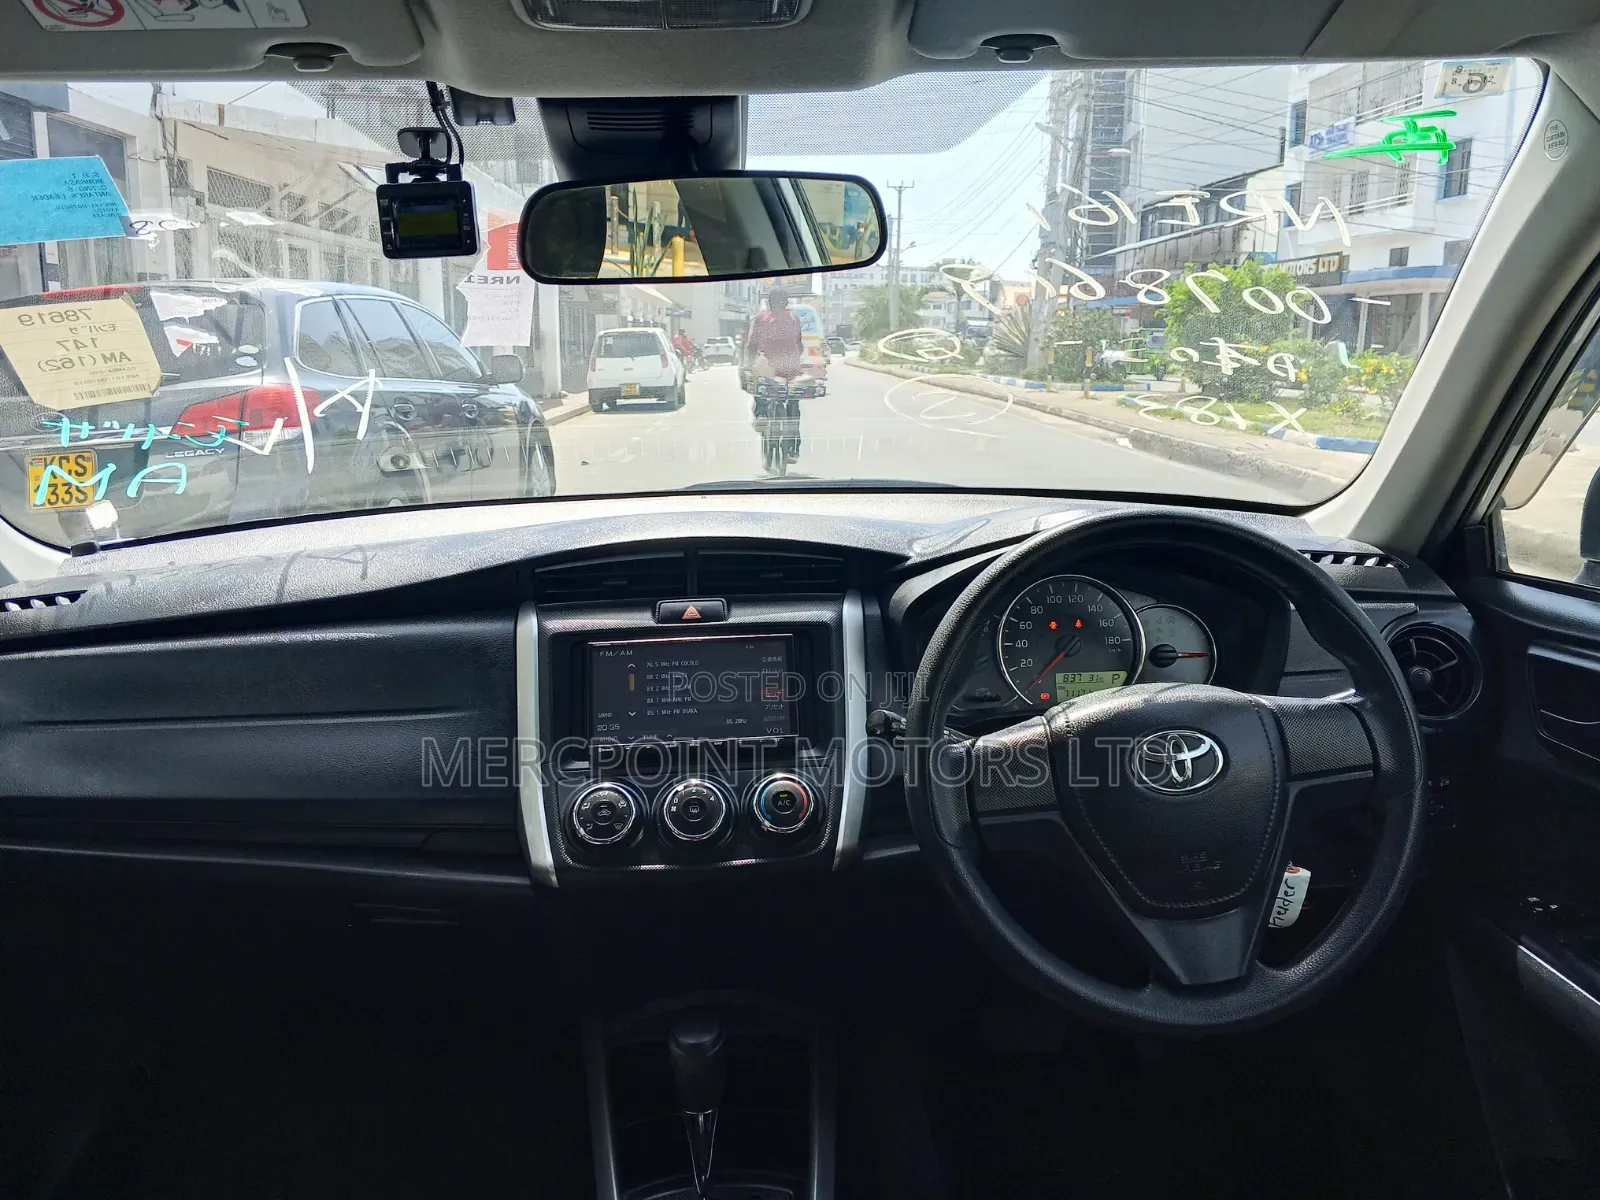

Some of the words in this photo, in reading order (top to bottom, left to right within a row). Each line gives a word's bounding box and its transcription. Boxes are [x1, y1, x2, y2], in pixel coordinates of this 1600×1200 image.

[1319, 255, 1340, 273] LTD
[165, 447, 225, 459] LEGACY
[43, 454, 89, 479] KCS
[1068, 595, 1084, 603] 120
[1031, 606, 1043, 614] 80
[1088, 604, 1103, 612] 140
[1020, 622, 1032, 630] 60
[1099, 619, 1115, 627] 160
[1015, 640, 1028, 648] 40
[1105, 637, 1121, 645] 180
[1020, 659, 1033, 667] 20
[1112, 674, 1120, 684] P
[777, 799, 791, 807] A/C
